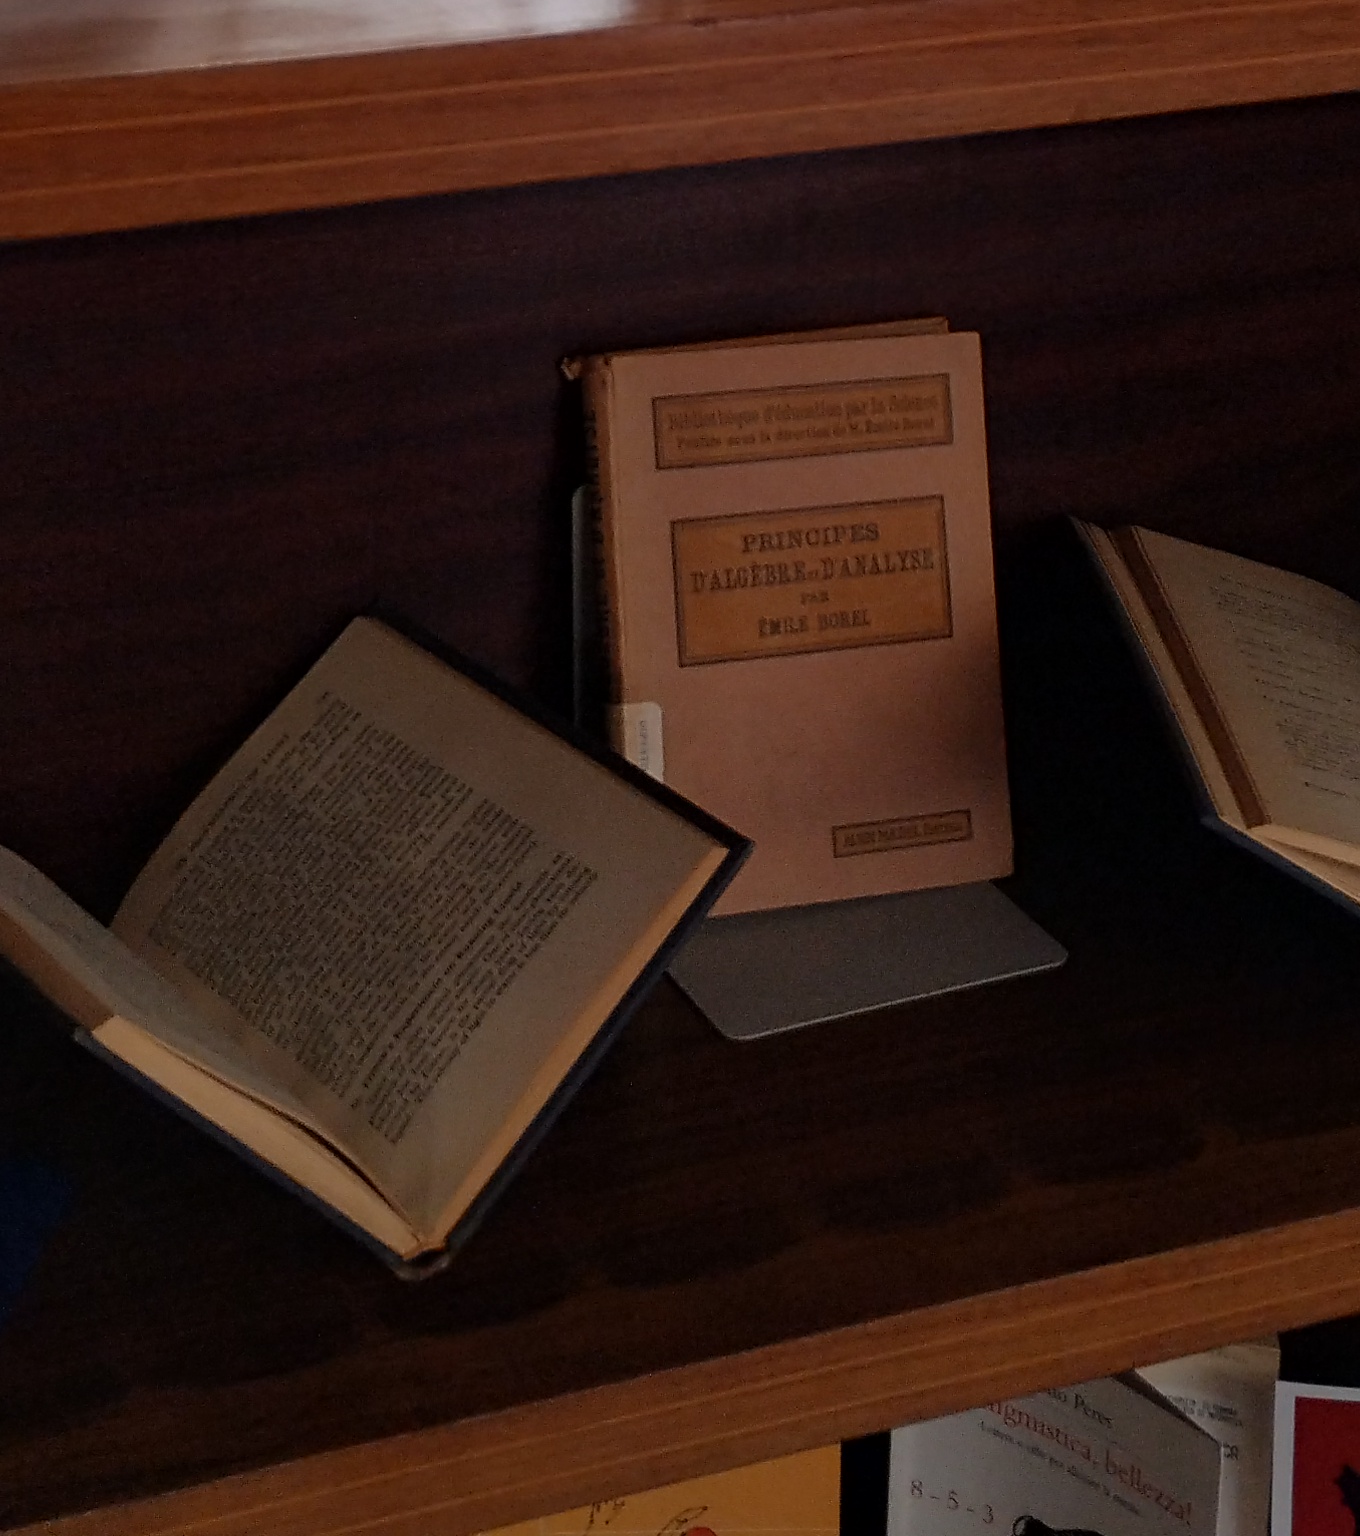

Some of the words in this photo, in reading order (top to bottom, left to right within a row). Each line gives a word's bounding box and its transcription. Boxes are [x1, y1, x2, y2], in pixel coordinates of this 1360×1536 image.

[742, 523, 880, 554] PRINCIPES
[911, 1479, 923, 1498] 8
[982, 1504, 994, 1524] 3
